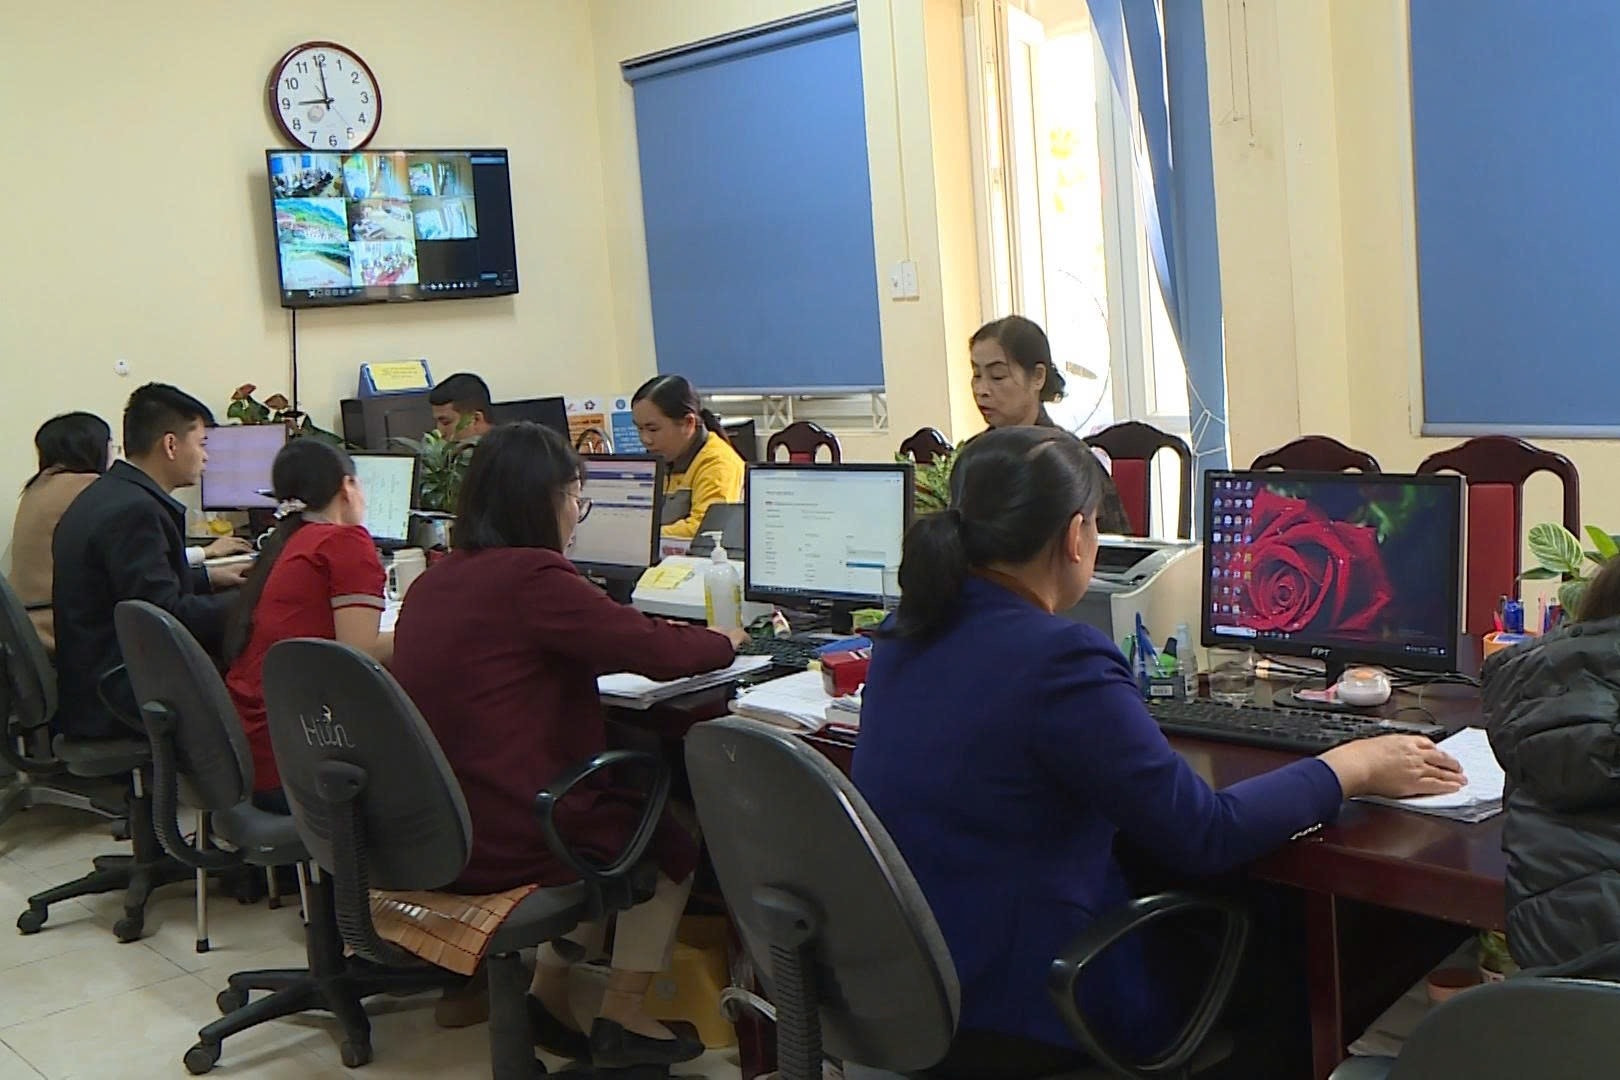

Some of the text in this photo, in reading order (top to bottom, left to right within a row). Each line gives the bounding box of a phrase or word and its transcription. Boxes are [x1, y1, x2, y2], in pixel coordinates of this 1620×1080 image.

[313, 53, 326, 68] 12
[336, 59, 342, 71] 1
[296, 61, 308, 74] 11
[285, 77, 299, 90] 10
[351, 71, 360, 84] 2
[281, 97, 291, 110] 9
[360, 91, 369, 104] 3
[292, 117, 302, 131] 8
[358, 112, 366, 124] 4
[308, 131, 318, 143] 7
[346, 127, 355, 140] 5
[328, 134, 338, 147] 6
